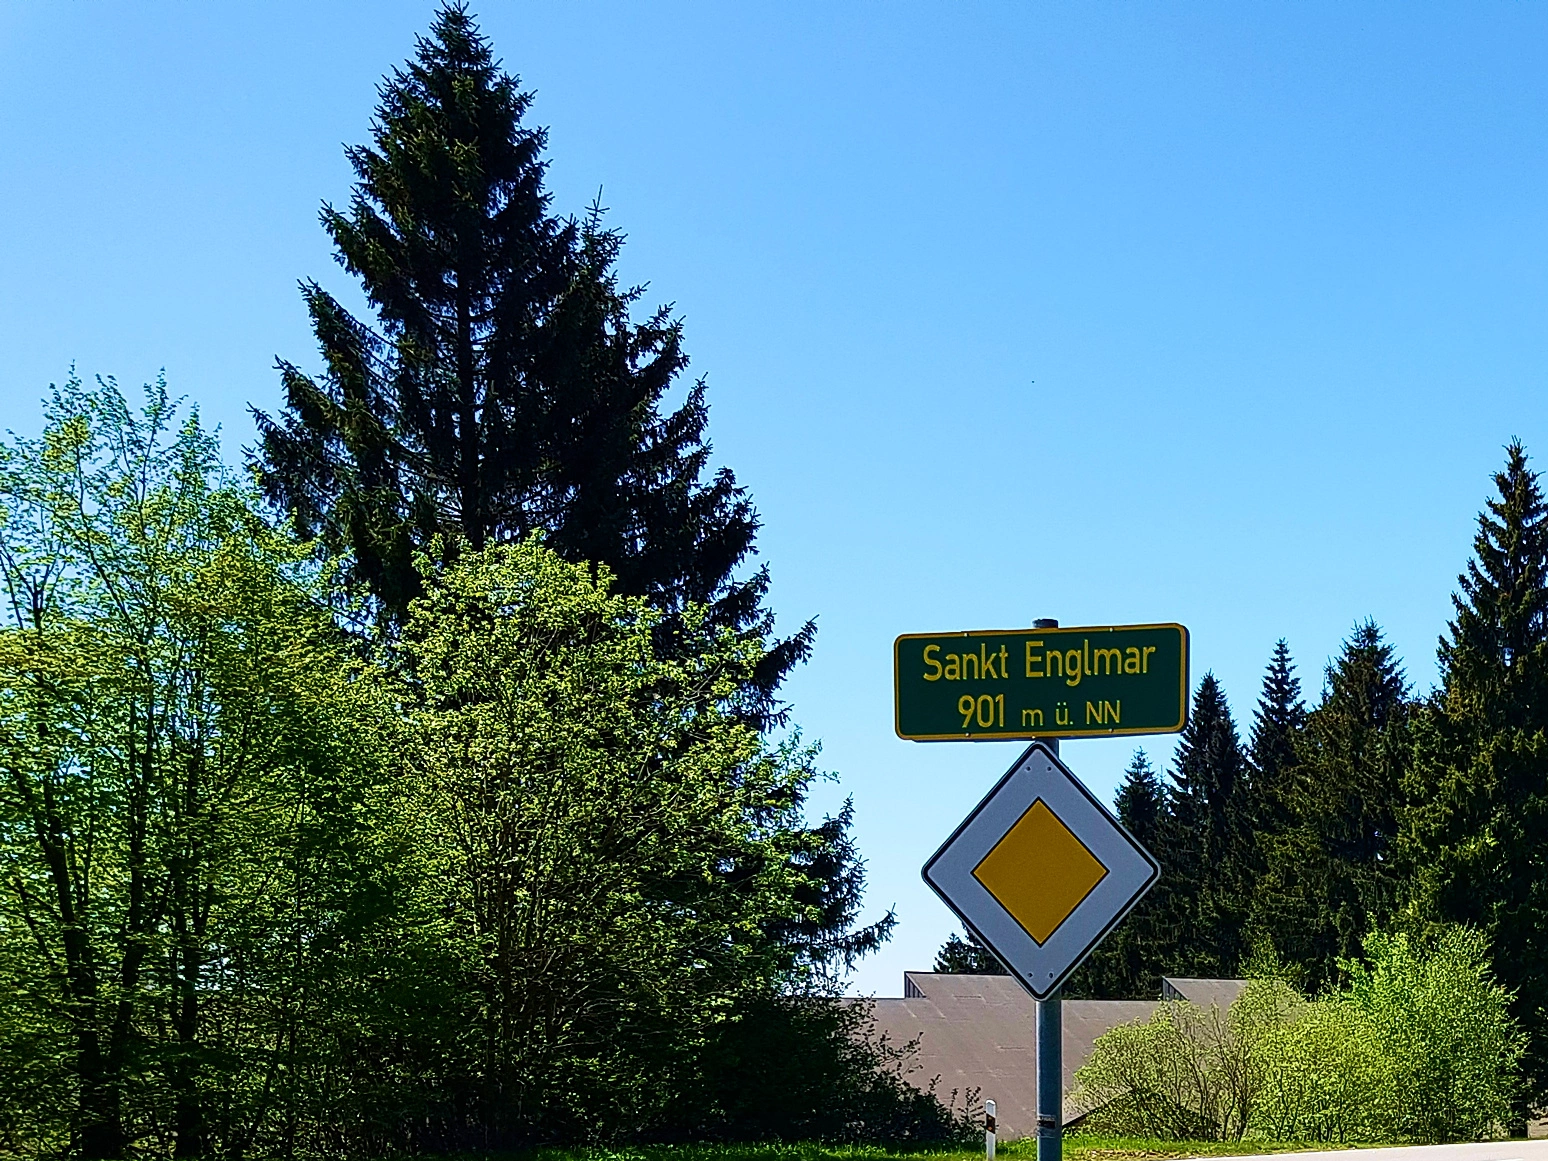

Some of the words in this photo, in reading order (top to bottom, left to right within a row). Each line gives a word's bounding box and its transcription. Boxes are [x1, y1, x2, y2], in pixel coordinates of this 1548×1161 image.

[922, 643, 1009, 681] Sankt
[1025, 639, 1156, 686] Englmar
[957, 694, 1005, 728] 901
[1021, 708, 1044, 727] m
[1054, 702, 1074, 726] ü.
[1085, 700, 1121, 725] NN
